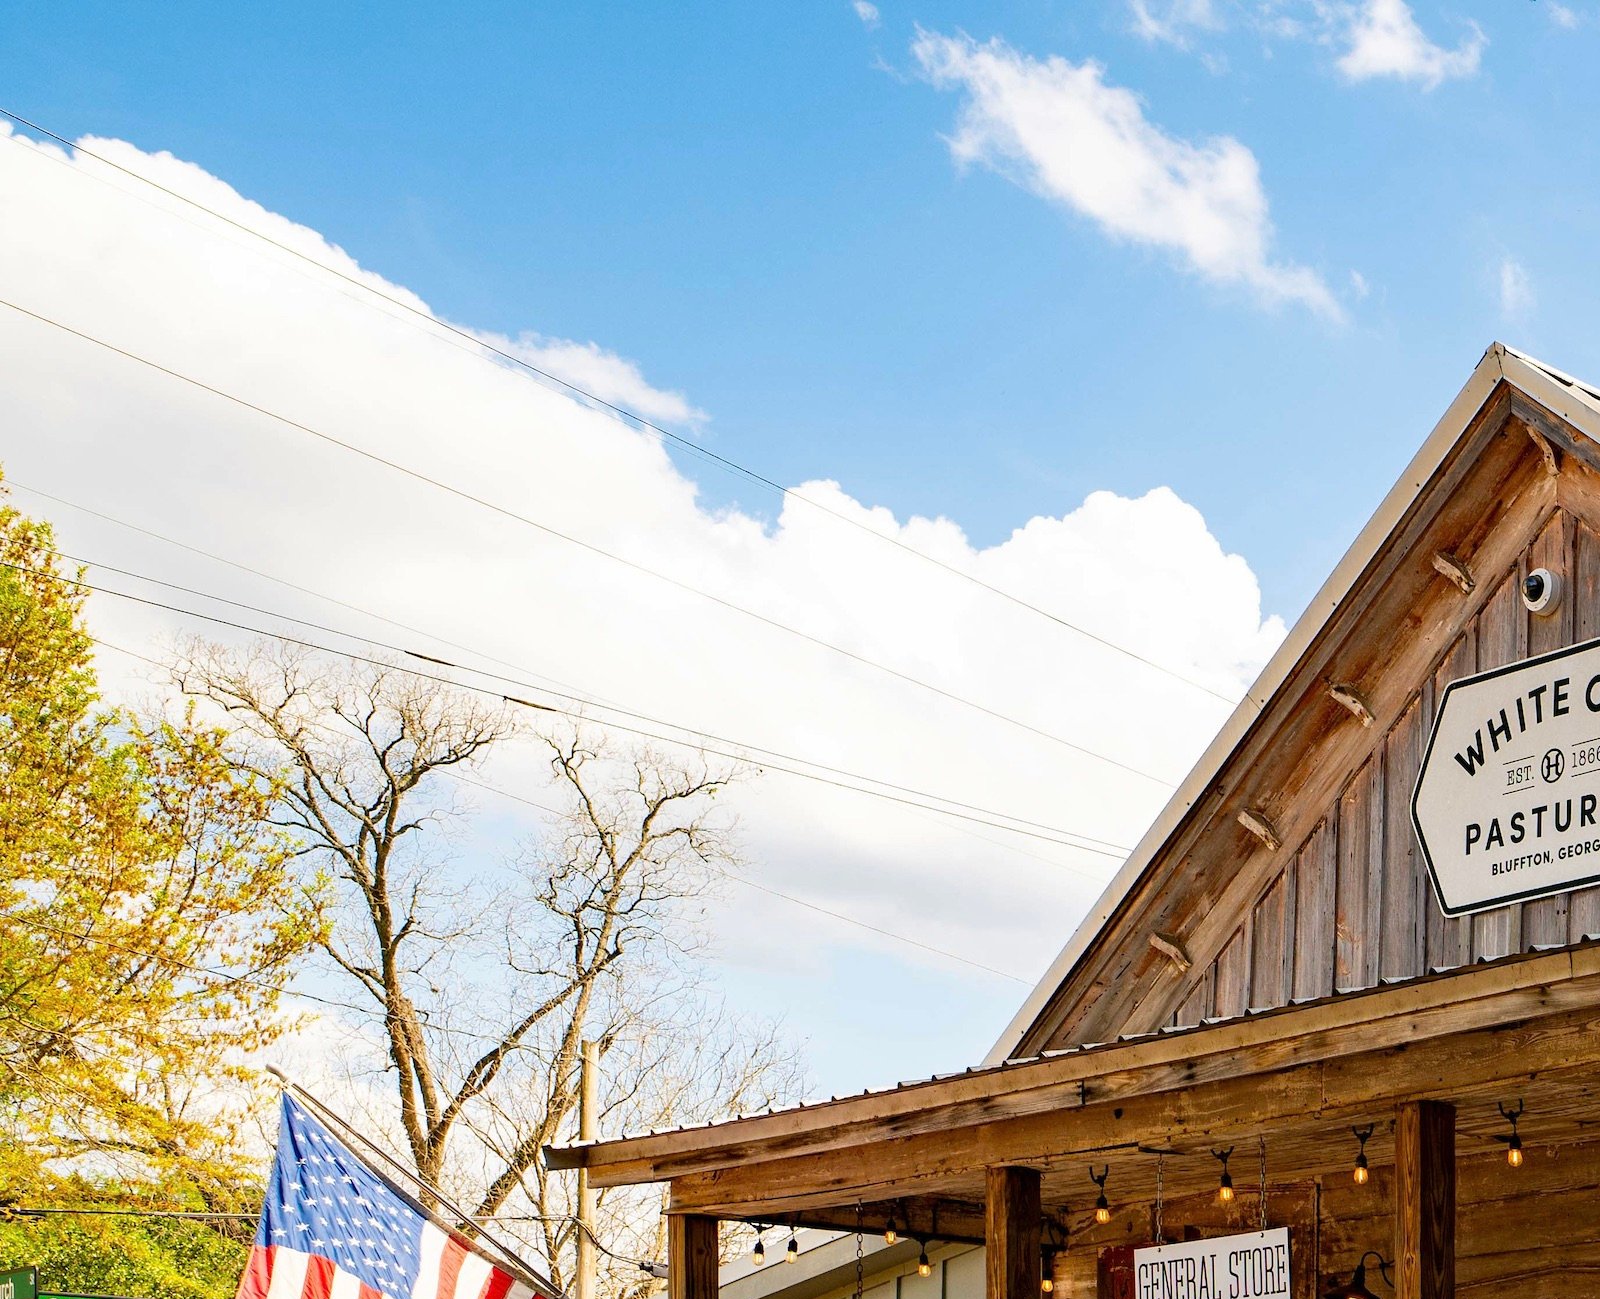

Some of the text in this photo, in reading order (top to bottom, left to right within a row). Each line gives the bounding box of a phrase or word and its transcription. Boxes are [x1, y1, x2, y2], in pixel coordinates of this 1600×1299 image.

[1454, 677, 1570, 777] WHITE
[1506, 765, 1534, 786] EST.
[1492, 850, 1554, 876] BLUFFTON,
[1228, 1244, 1286, 1299] STORE
